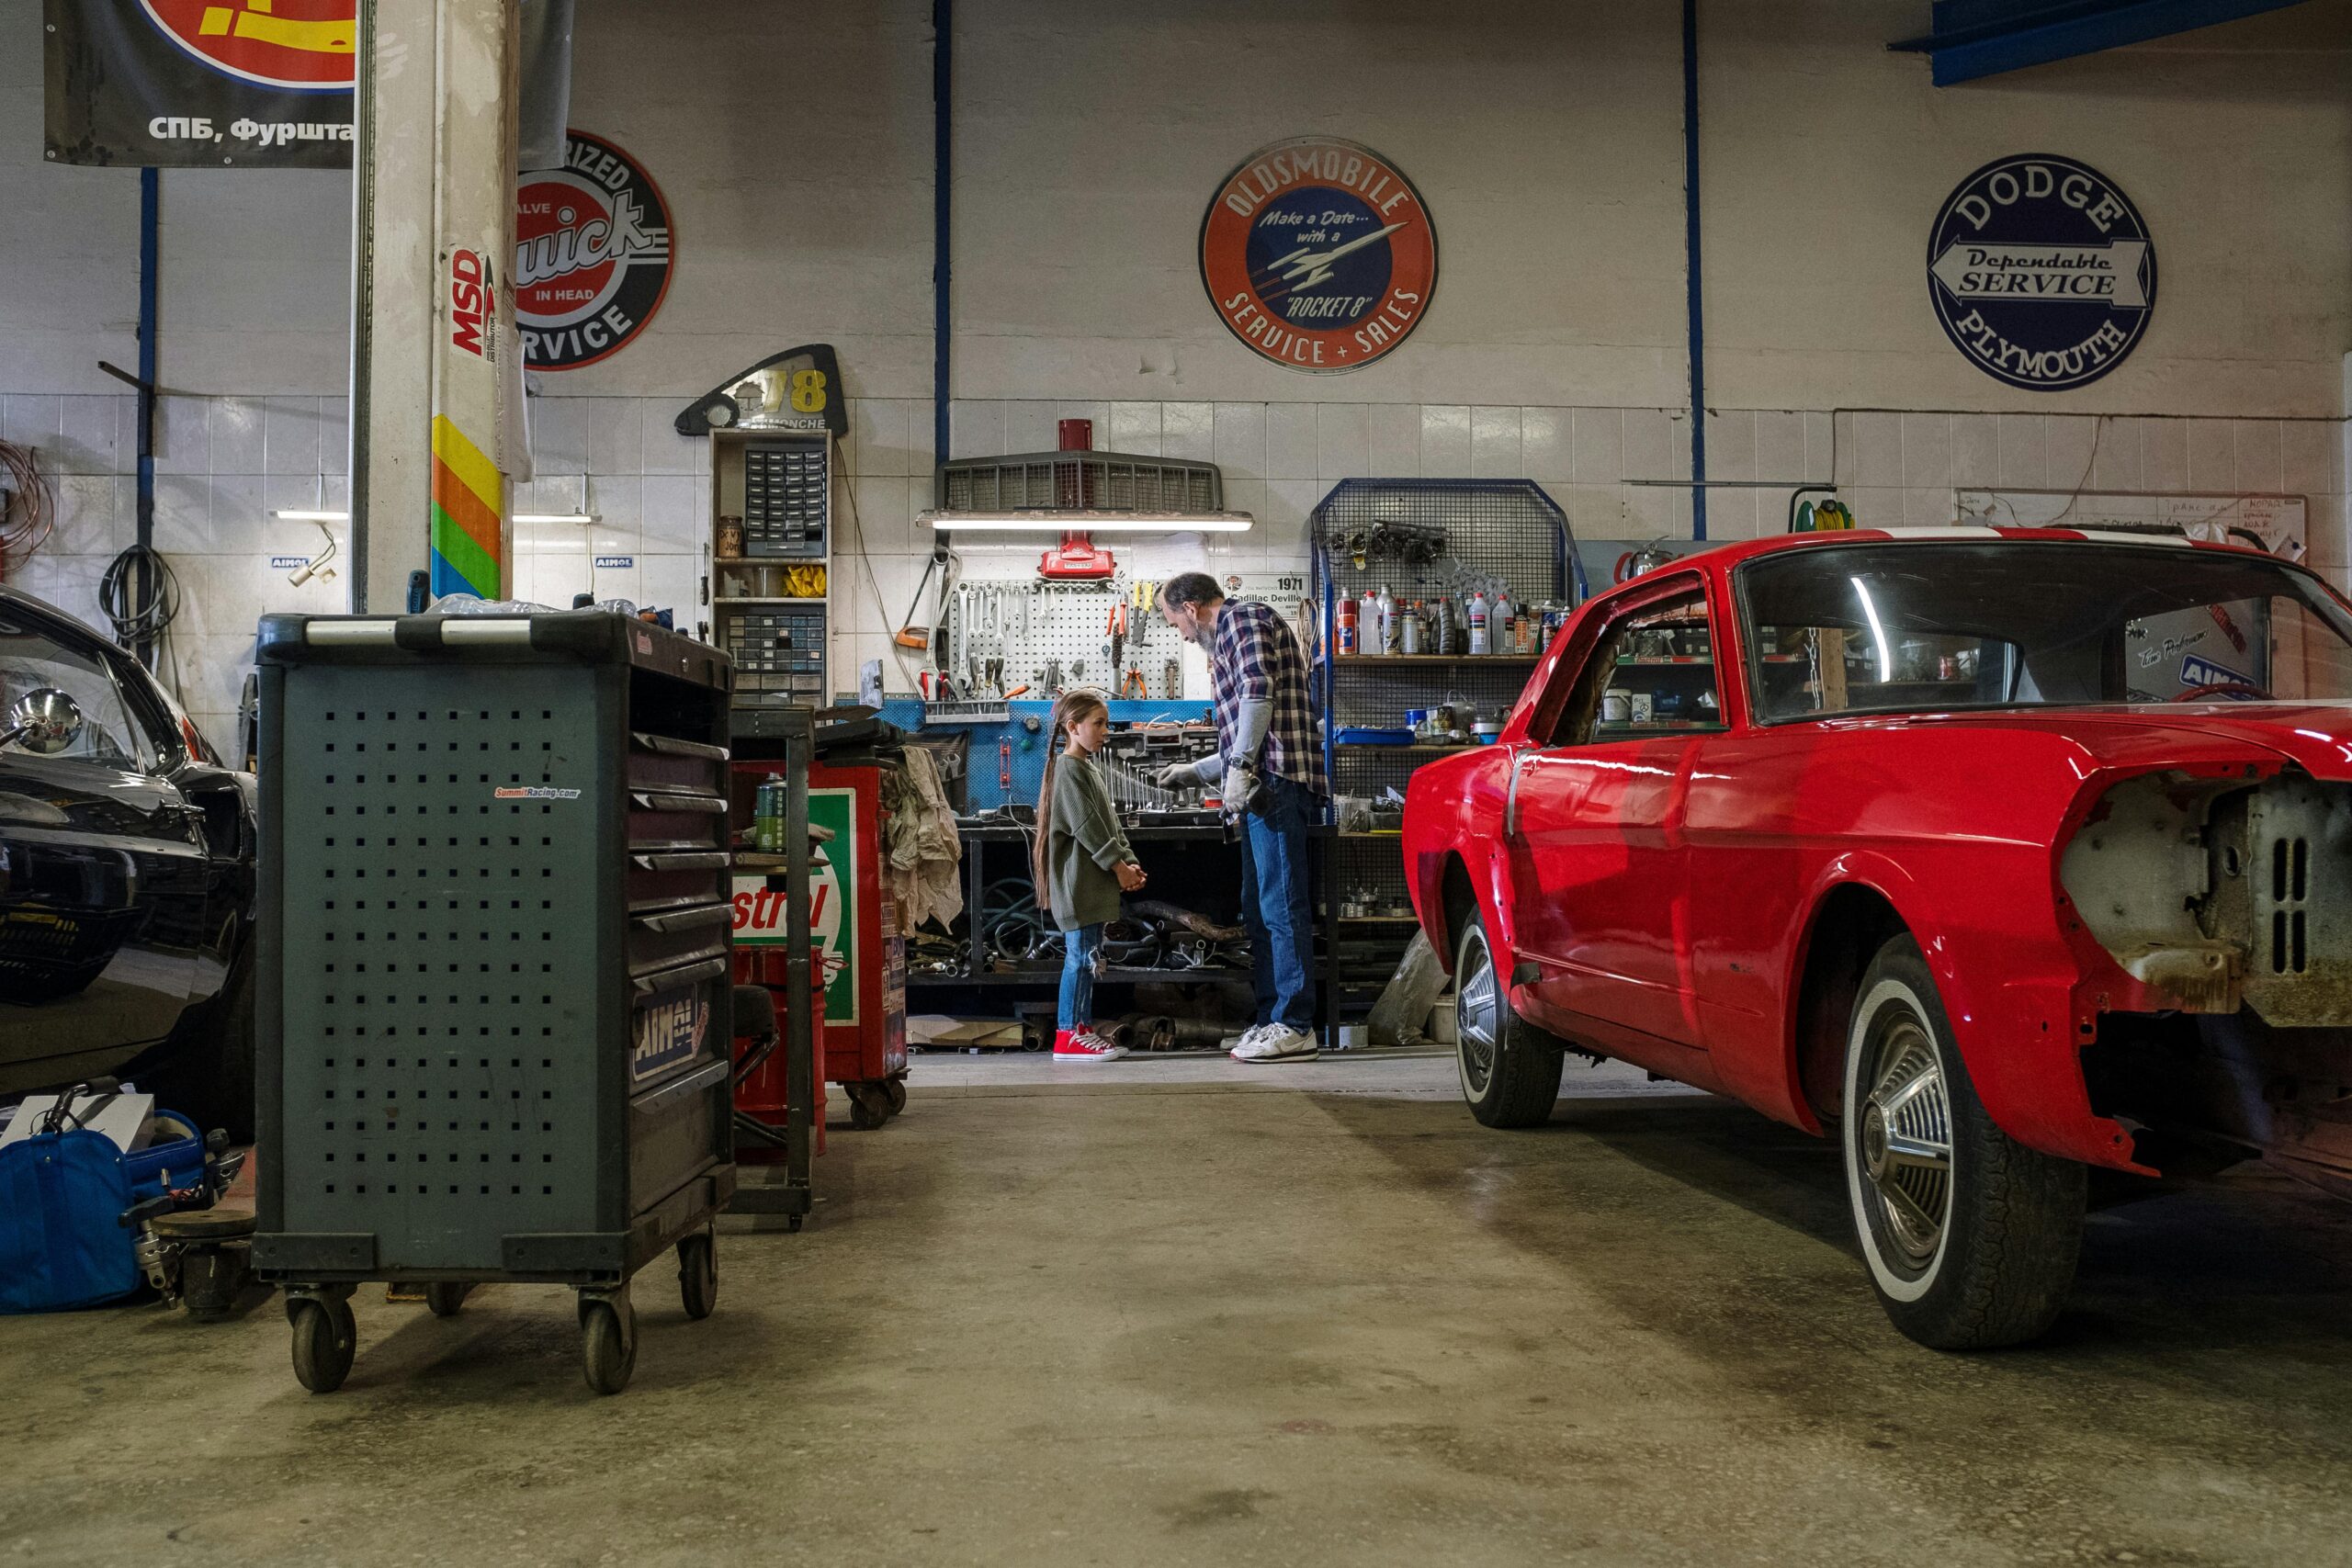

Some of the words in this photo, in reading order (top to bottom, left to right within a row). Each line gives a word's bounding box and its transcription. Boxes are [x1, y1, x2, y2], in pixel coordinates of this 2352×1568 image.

[148, 117, 223, 143] СПБ,
[230, 118, 355, 146] Фуршта
[564, 140, 630, 190] RIZED
[1225, 149, 1410, 219] OLDSMOBILE
[1955, 165, 2124, 233] DODGE
[517, 203, 551, 214] ALVE
[1260, 210, 1304, 227] Make
[1306, 215, 1317, 226] a
[516, 188, 653, 288] uick
[1296, 229, 1326, 243] with
[1330, 231, 1340, 243] a
[1966, 248, 2112, 272] Dependable
[536, 289, 551, 301] IN
[555, 289, 595, 301] HEAD
[1959, 272, 2117, 296] SERVICE
[452, 248, 483, 357] MSD
[522, 304, 634, 360] RVICE
[1225, 291, 1325, 364] SERVICE
[1355, 287, 1419, 354] SALES
[1956, 309, 2127, 378] PLYMOUTH
[763, 368, 827, 413] 78
[596, 558, 632, 567] AIMOL
[1272, 593, 1302, 603] Deville
[1277, 577, 1303, 591] 1971
[2183, 663, 2253, 699] AIM
[495, 786, 581, 798] SummitRacing.com
[732, 884, 830, 931] strl
[635, 998, 695, 1062] AIMOL
